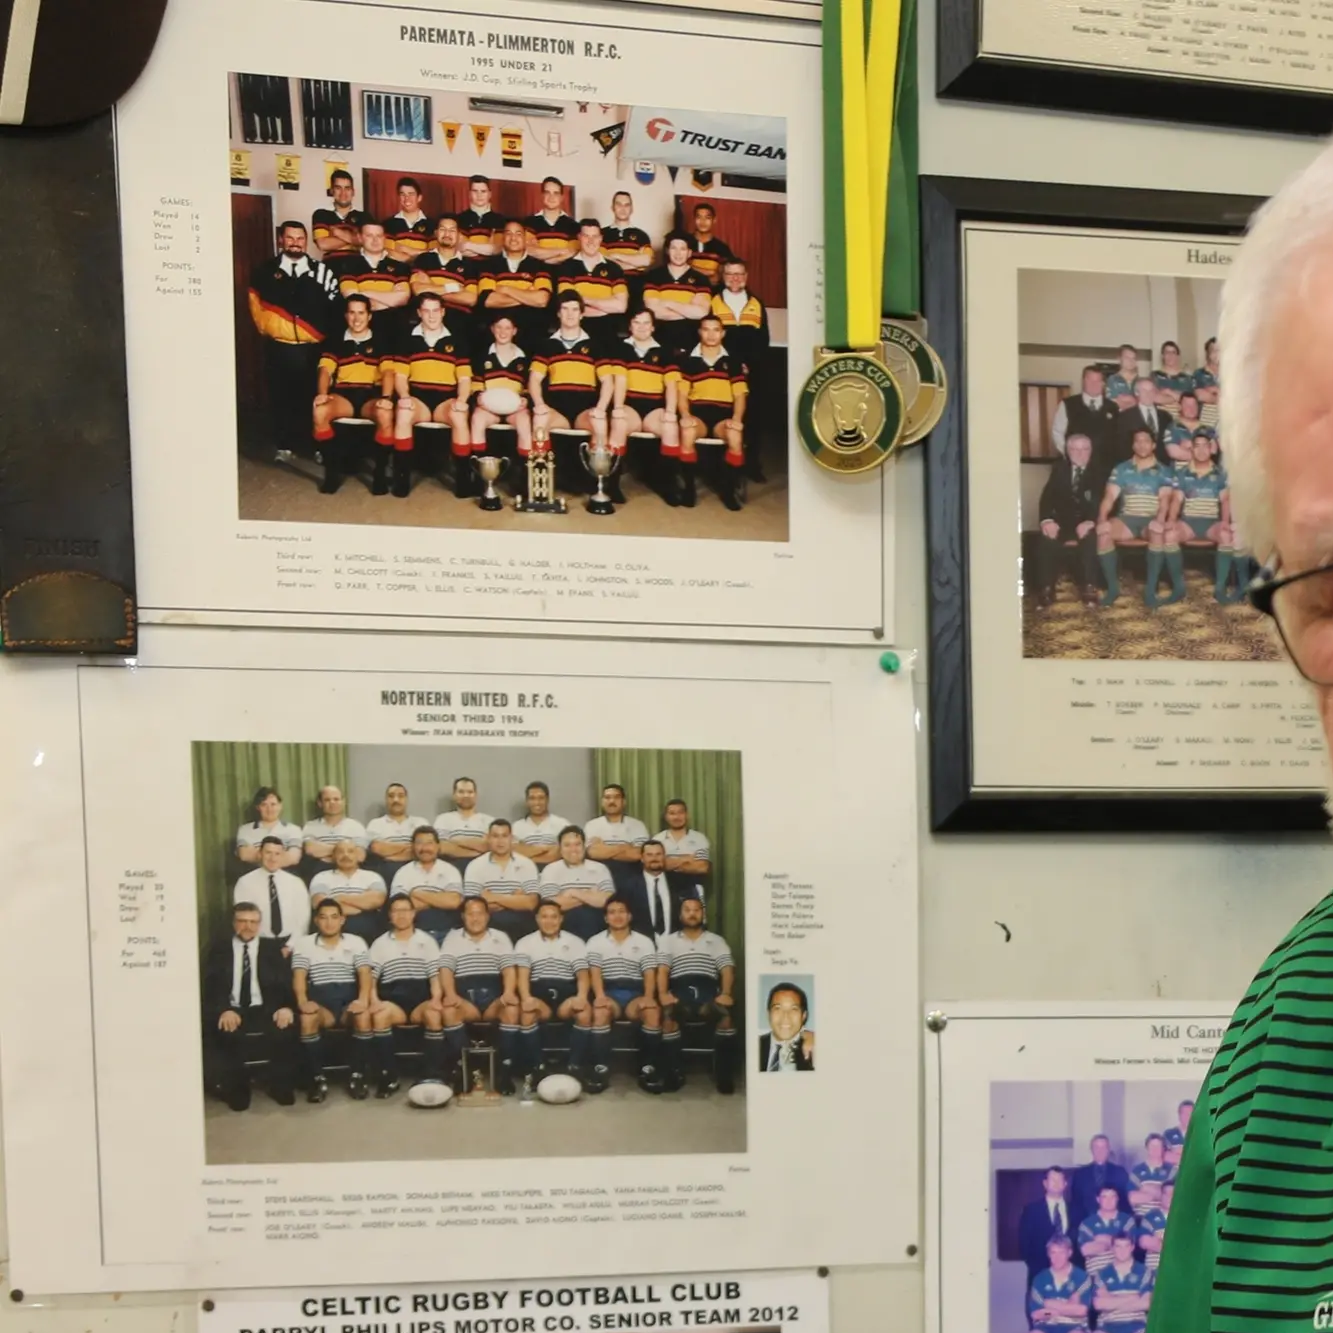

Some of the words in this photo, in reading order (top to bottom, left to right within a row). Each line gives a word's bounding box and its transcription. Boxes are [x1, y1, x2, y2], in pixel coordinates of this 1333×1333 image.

[400, 25, 476, 47] PAREMATA
[487, 33, 575, 56] PLIMMERTON
[584, 42, 622, 60] R.F.C.
[471, 57, 495, 68] 1995
[500, 59, 536, 72] UNDER
[542, 63, 553, 73] 21
[420, 68, 459, 82] Winners:
[507, 77, 538, 90] Stirling
[540, 80, 567, 92] Sports
[569, 82, 599, 95] Trophy
[679, 129, 744, 154] TRUST
[806, 360, 866, 394] WATTERS
[866, 364, 893, 389] CUP
[381, 690, 452, 707] NORTHERN
[461, 691, 508, 708] UNITED
[518, 692, 559, 709] R.F.C.
[417, 713, 457, 723] SENIOR
[463, 714, 495, 724] THIRD
[501, 715, 524, 724] 1996
[1150, 1024, 1180, 1039] Mid
[301, 1294, 402, 1317] CELTIC
[411, 1290, 509, 1313] RUGBY
[519, 1285, 661, 1308] FOOTBALL
[670, 1282, 742, 1301] CLUB
[543, 1315, 581, 1332] CO.
[589, 1311, 673, 1330] SENIOR
[680, 1308, 741, 1326] TEAM
[748, 1305, 799, 1322] 2012
